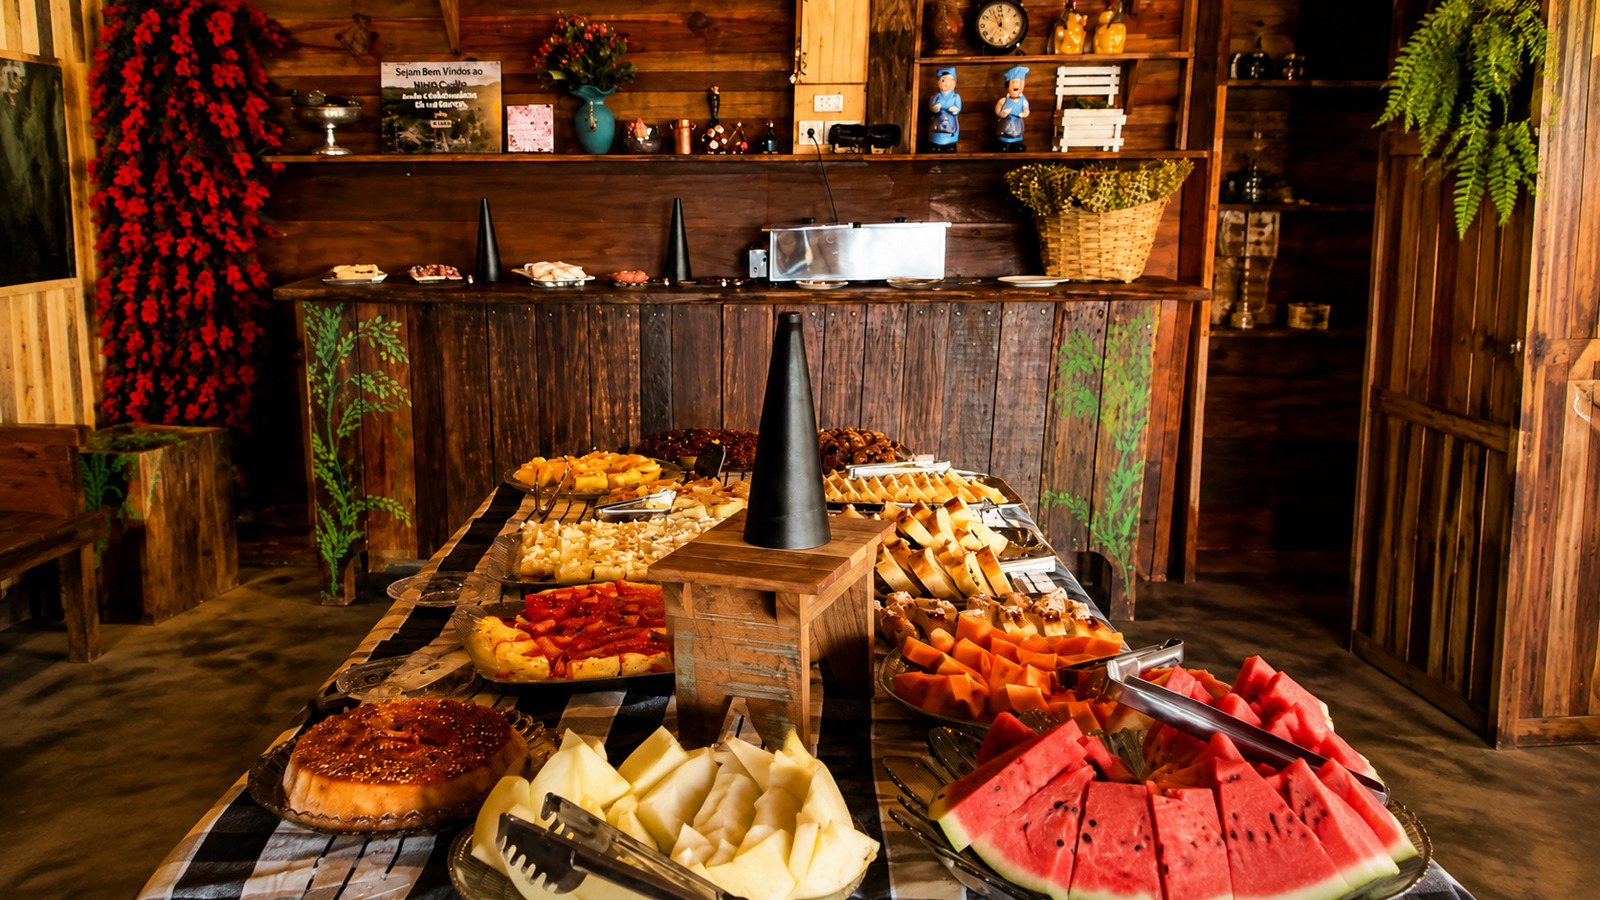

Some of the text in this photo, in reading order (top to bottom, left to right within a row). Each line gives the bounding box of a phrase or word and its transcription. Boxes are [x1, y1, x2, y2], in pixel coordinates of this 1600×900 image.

[396, 66, 483, 78] Sejam Bem Vindos ao
